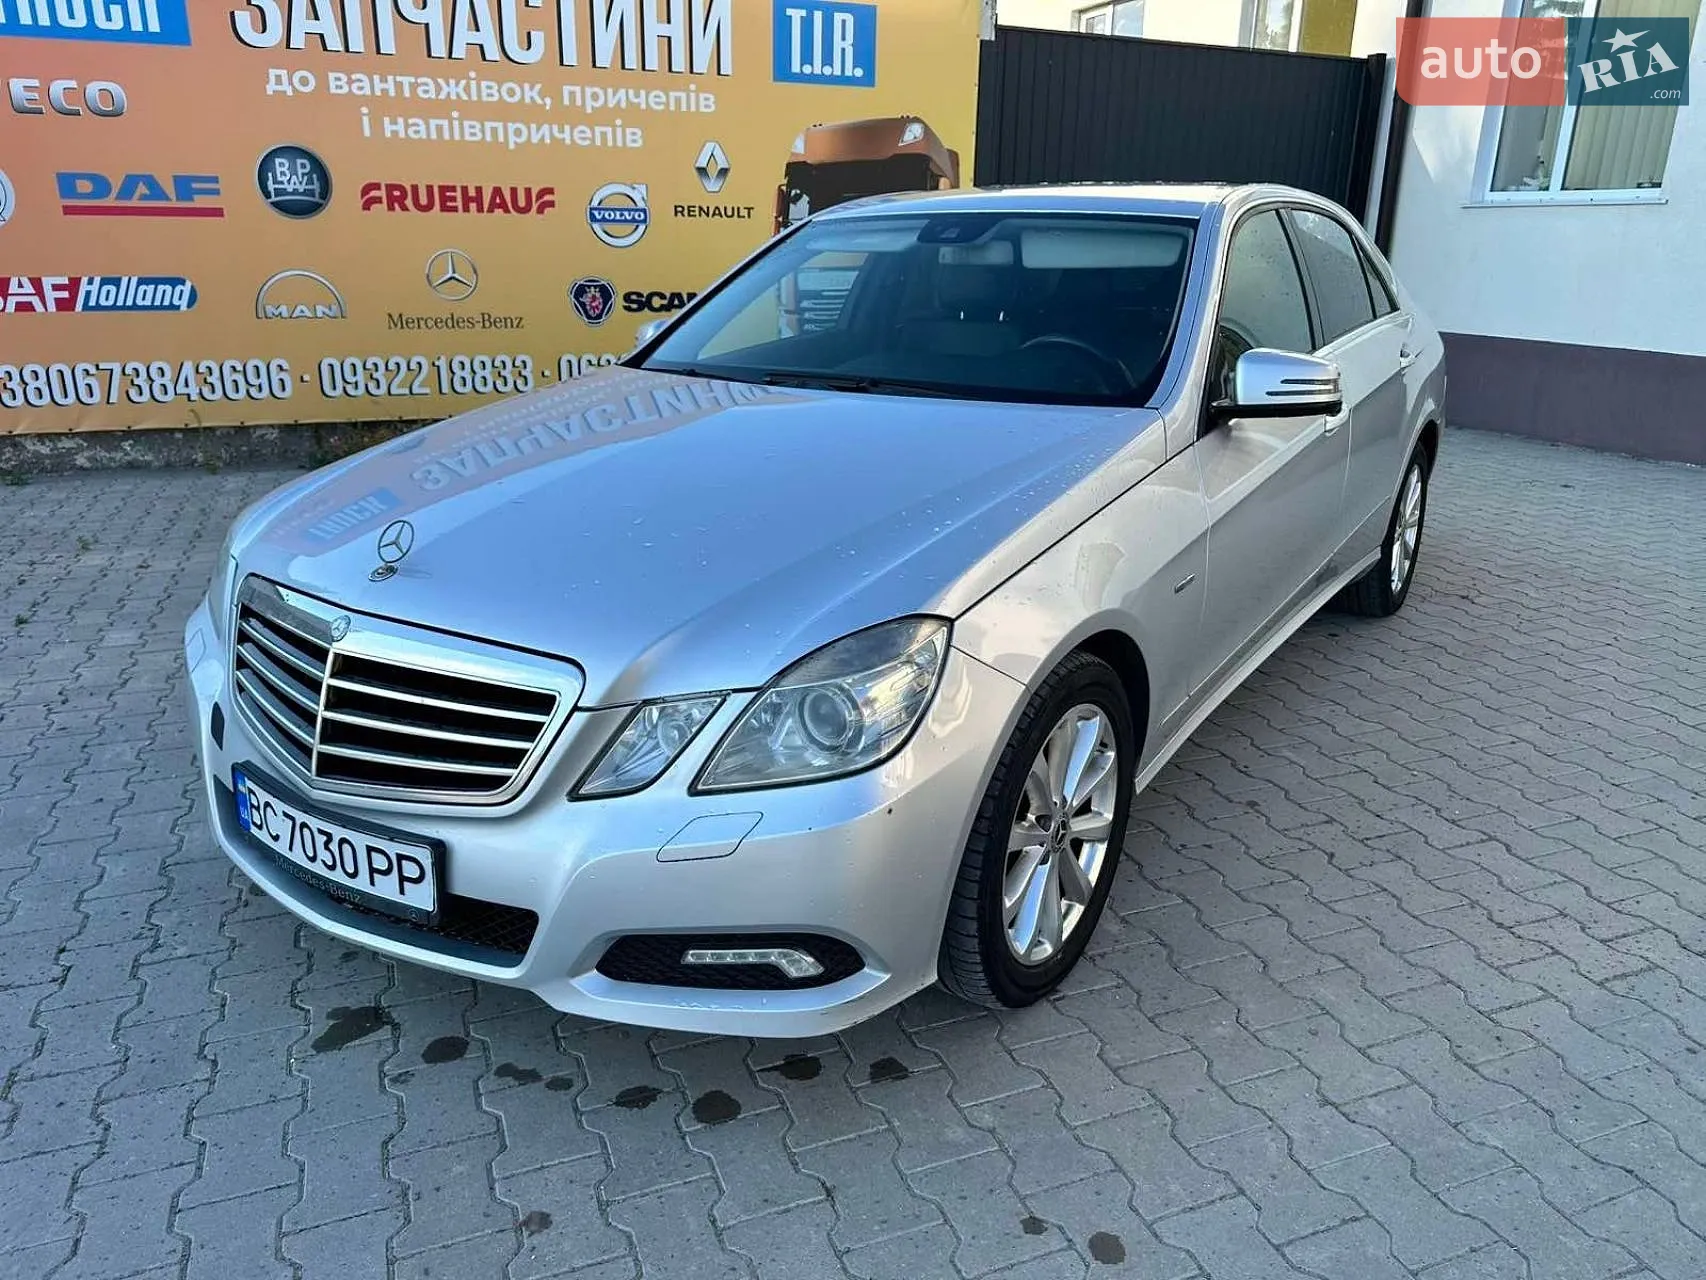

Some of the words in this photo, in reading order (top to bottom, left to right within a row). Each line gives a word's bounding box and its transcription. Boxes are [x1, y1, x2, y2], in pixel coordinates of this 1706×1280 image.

[230, 0, 733, 76] ЗАПЧАСТИНИ
[785, 8, 864, 78] T.I.R.
[0, 78, 127, 117] ECO
[266, 68, 316, 95] до
[328, 71, 551, 109] вантажівок,
[563, 84, 716, 113] причепів
[361, 106, 371, 137] і
[384, 110, 643, 149] напівпричепів
[56, 172, 221, 202] DAF
[360, 181, 555, 215] FRUEHAUF
[592, 208, 646, 221] VOLVO
[674, 204, 754, 219] RENAULT
[0, 276, 69, 312] AF
[75, 276, 193, 312] Holland
[264, 303, 338, 319] MAN
[387, 312, 524, 330] Mercedes-Benz
[0, 358, 293, 408] 380673843696
[319, 354, 534, 398] 0932218833
